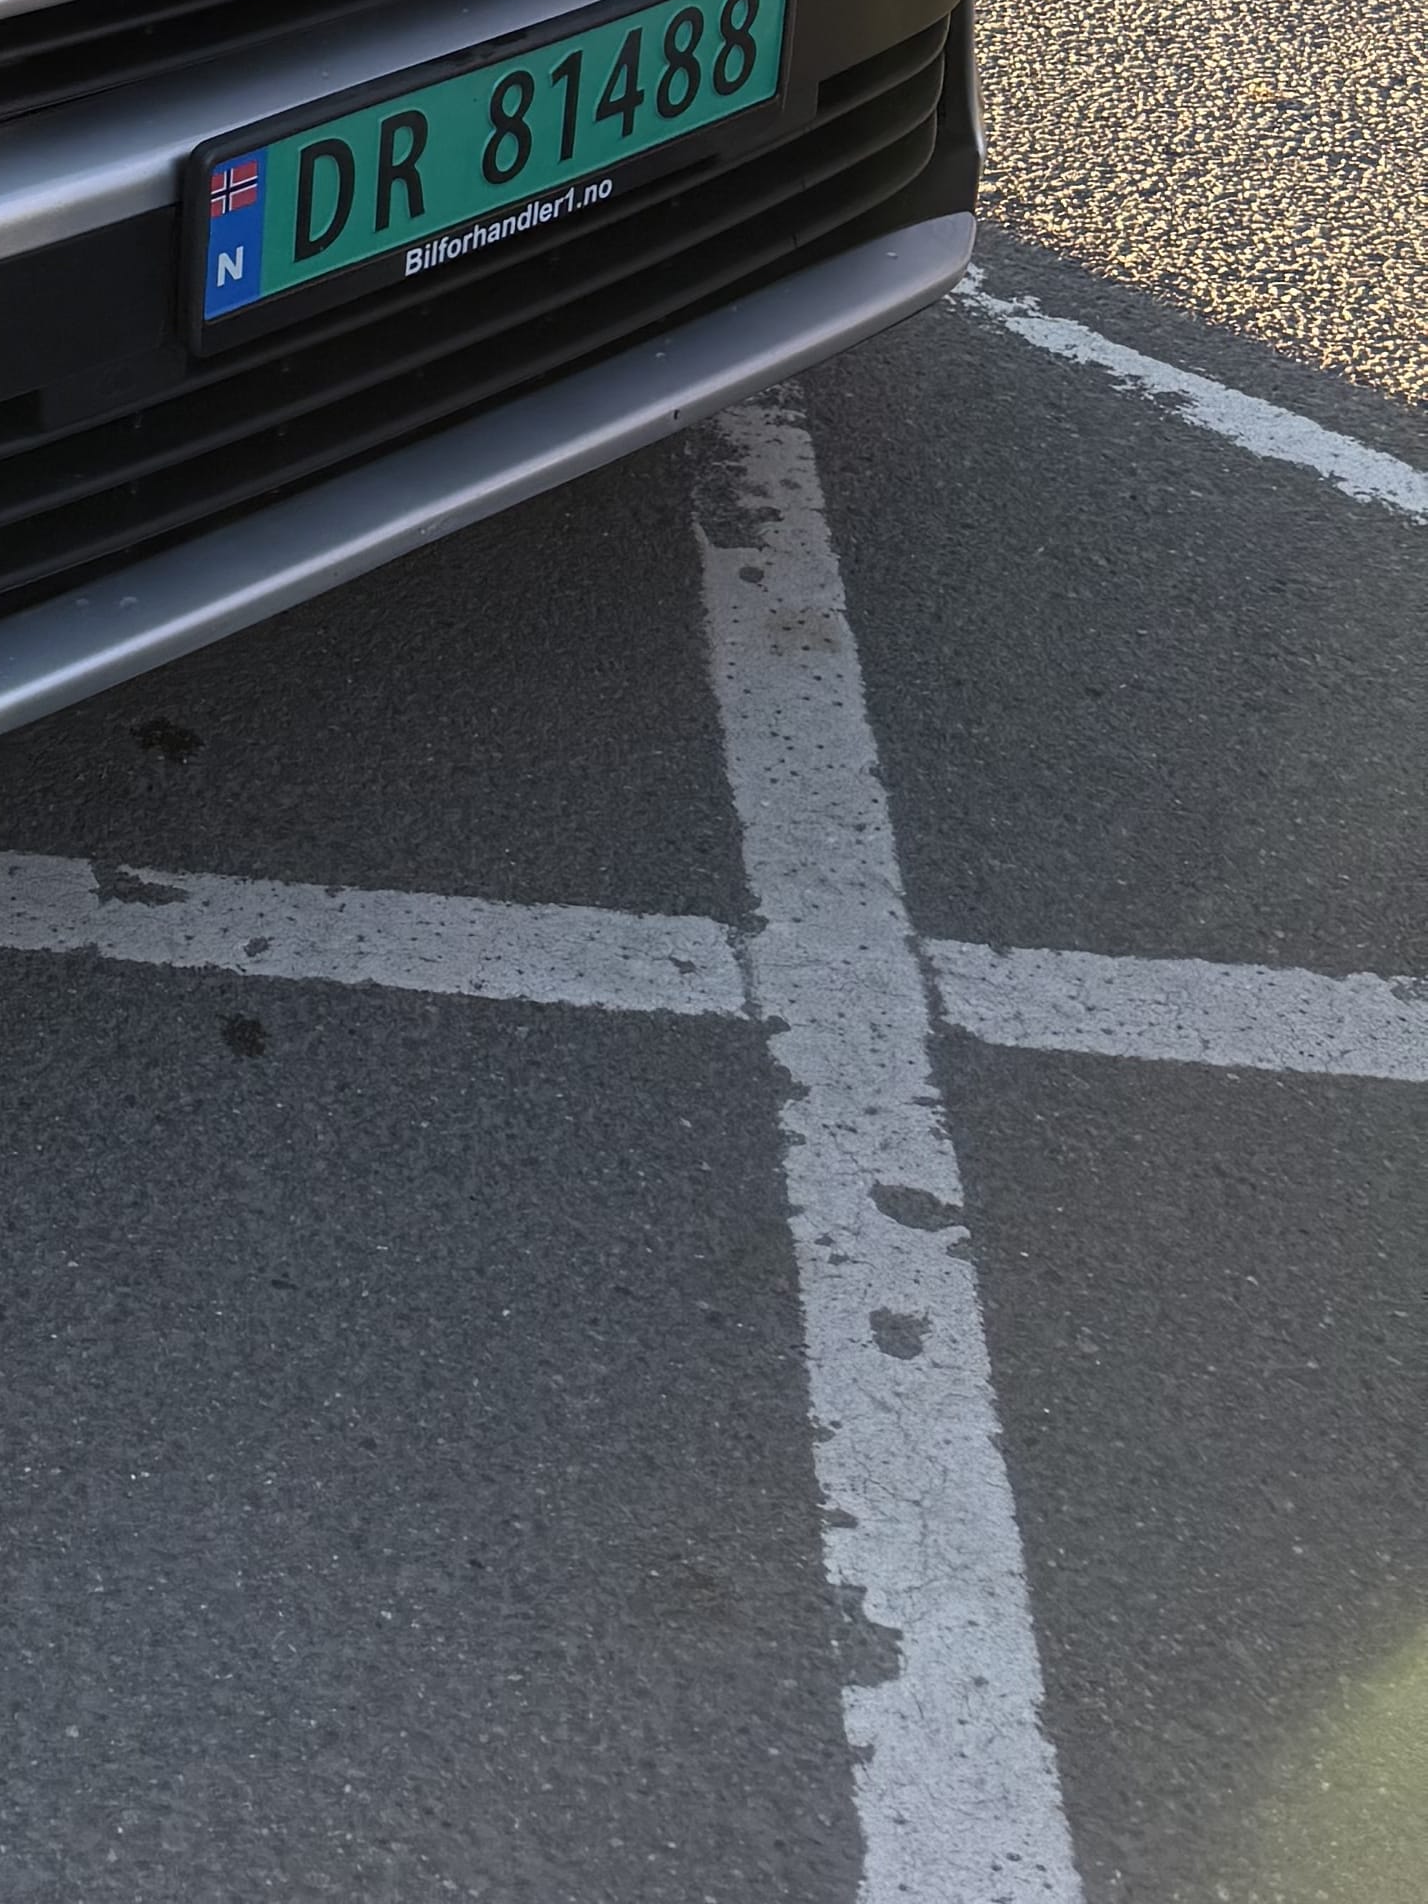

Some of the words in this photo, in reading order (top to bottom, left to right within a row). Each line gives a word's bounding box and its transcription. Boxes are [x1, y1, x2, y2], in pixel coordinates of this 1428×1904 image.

[293, 109, 428, 263] DR
[405, 179, 613, 277] Bilforhandler1.no
[217, 246, 244, 287] N
